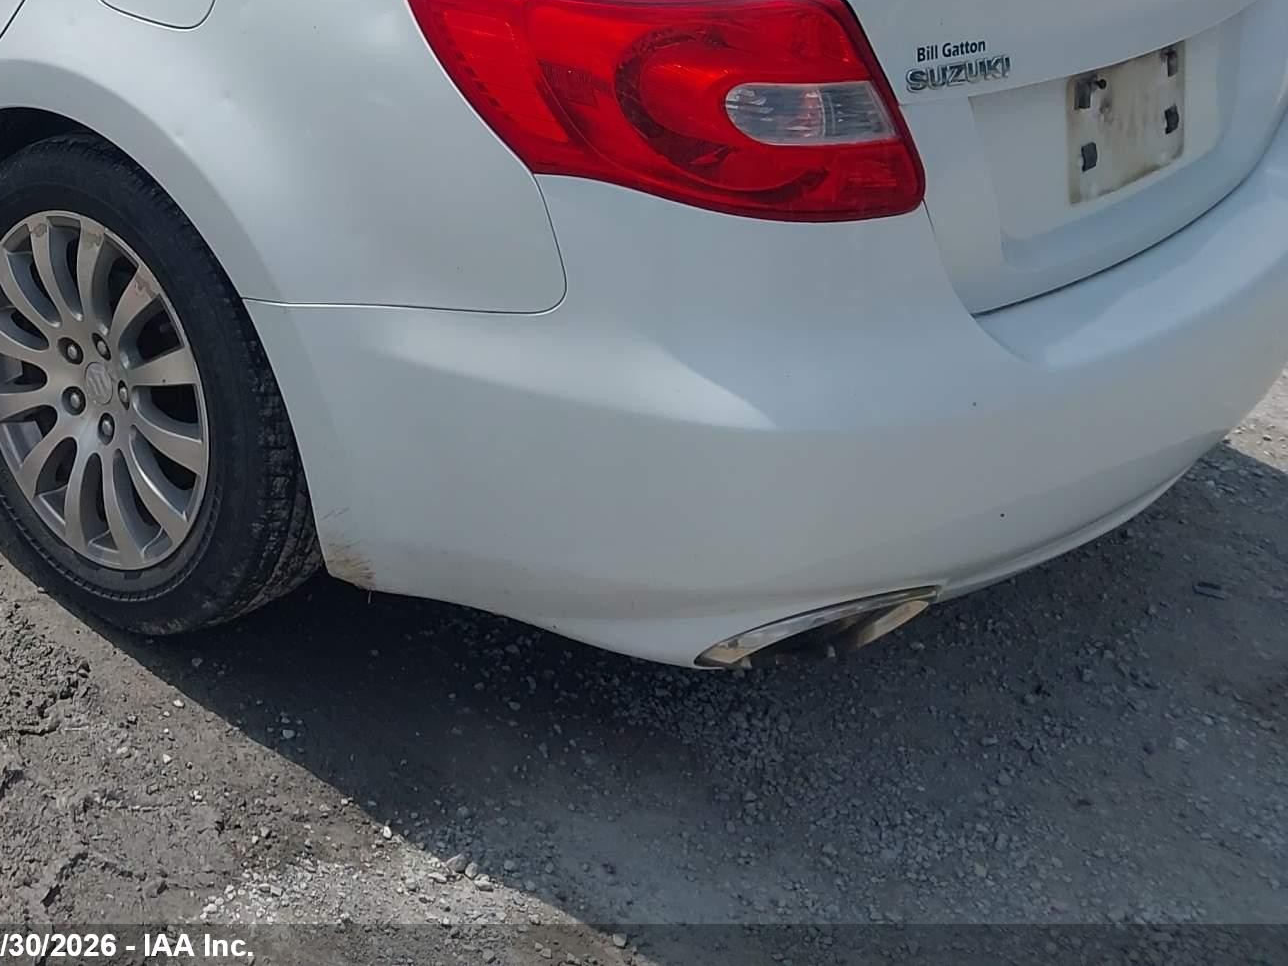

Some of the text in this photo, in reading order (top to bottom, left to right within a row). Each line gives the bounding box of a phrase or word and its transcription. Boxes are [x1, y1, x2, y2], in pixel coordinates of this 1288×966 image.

[917, 40, 986, 63] Bill Gatton
[906, 55, 1010, 93] SUZUKI
